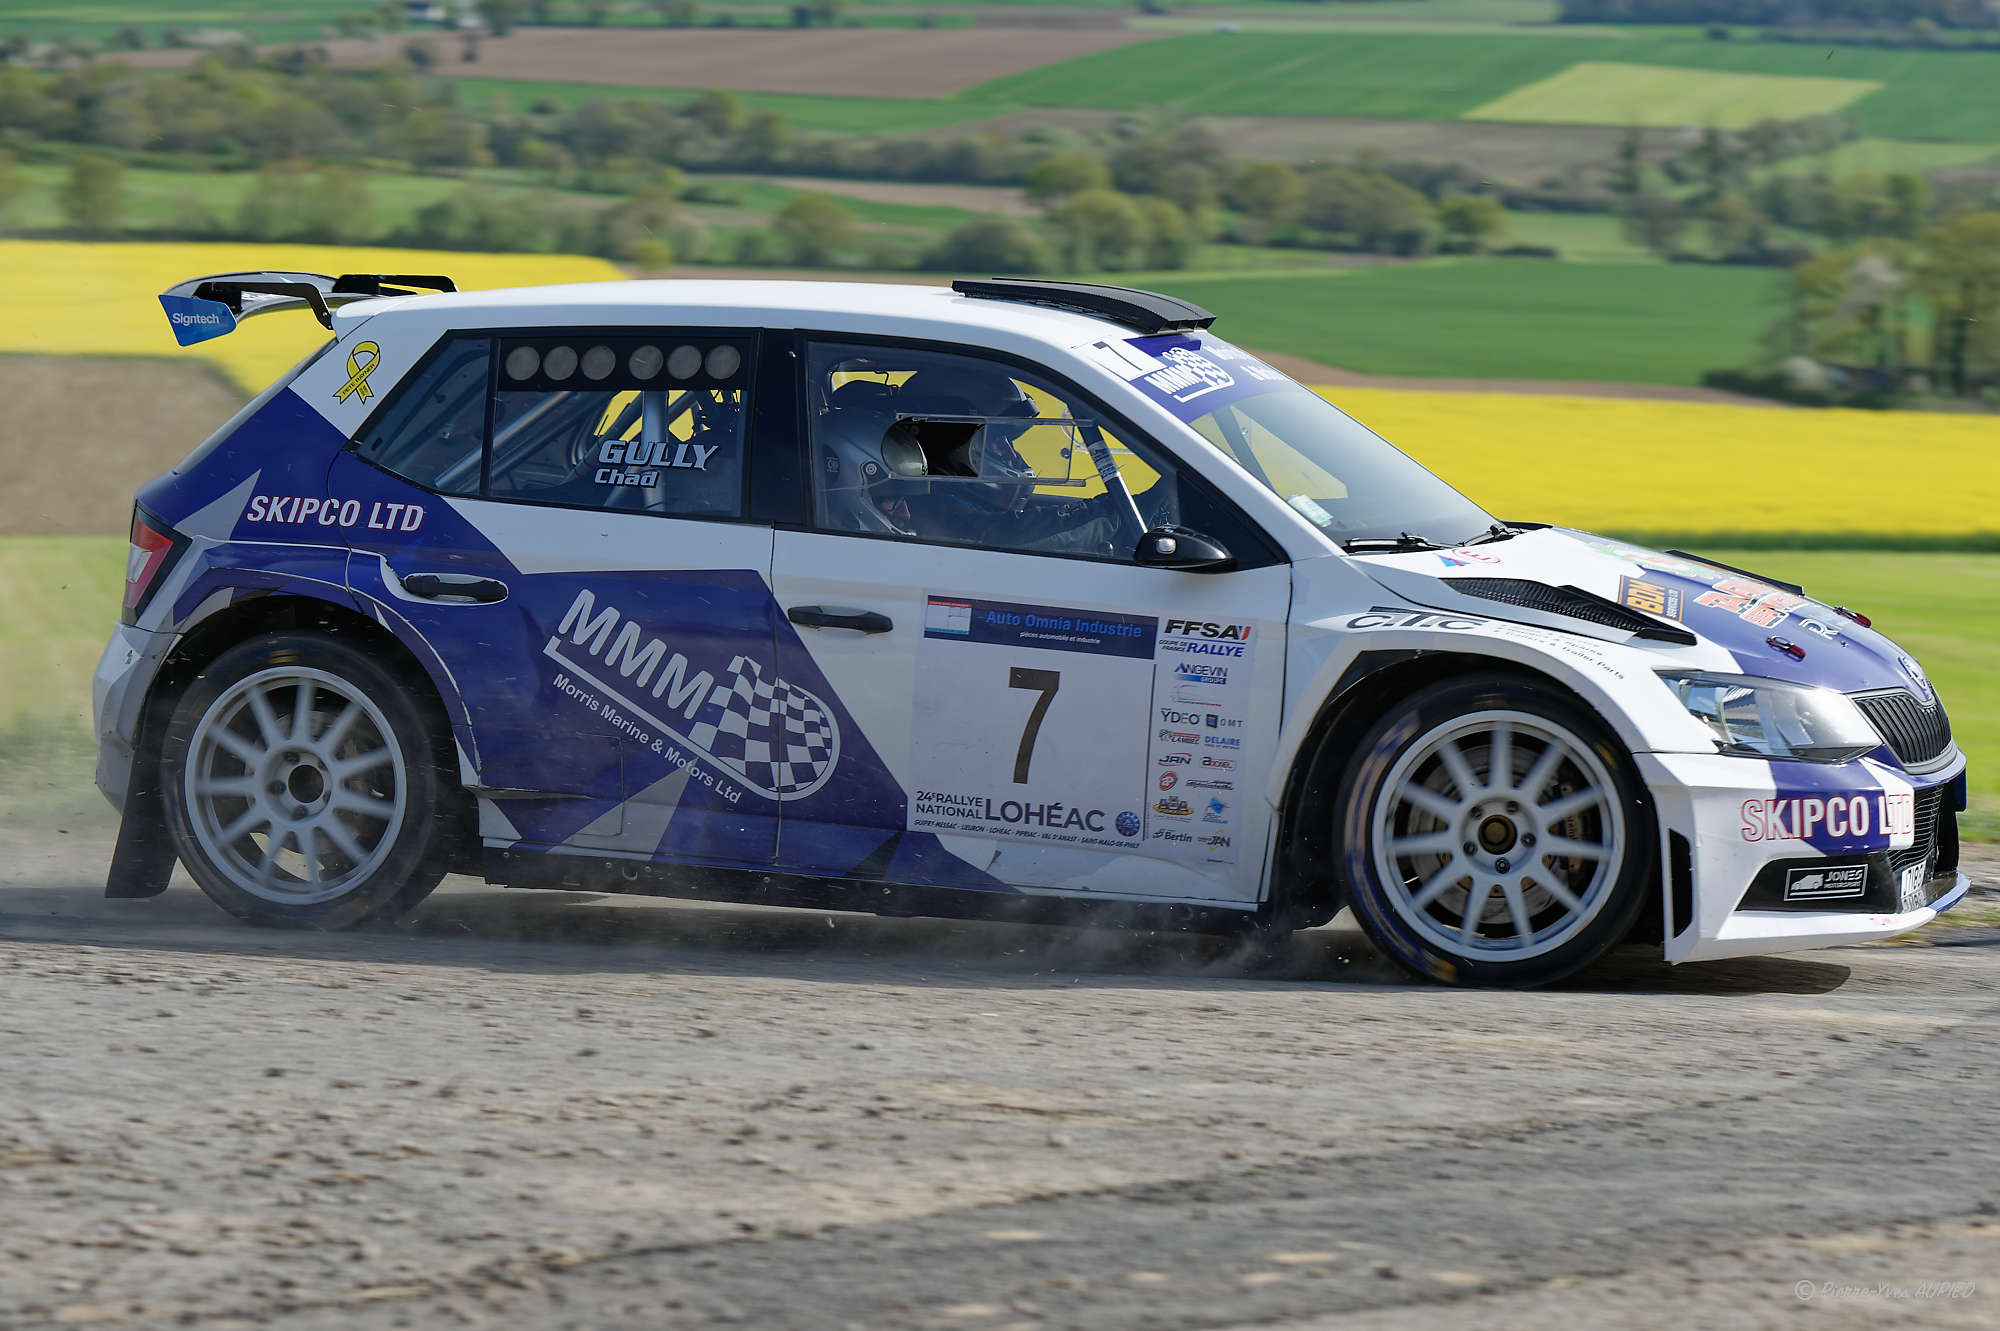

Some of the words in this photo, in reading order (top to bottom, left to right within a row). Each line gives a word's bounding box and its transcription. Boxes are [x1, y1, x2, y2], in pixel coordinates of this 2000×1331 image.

[172, 312, 219, 326] Signtech
[598, 440, 719, 469] GULLY
[594, 468, 659, 487] Chad
[246, 495, 362, 528] SKIPCO
[368, 502, 425, 532] LTD
[985, 610, 1021, 626] Auto
[1025, 613, 1071, 632] Omnia
[1075, 620, 1143, 638] Industrie
[1164, 619, 1240, 640] FFSA
[558, 588, 714, 720] MMM
[1186, 642, 1244, 657] RALLYE
[1174, 664, 1228, 676] ANGEVIN
[1009, 667, 1061, 784] 7
[553, 673, 600, 711] Morris
[600, 704, 650, 744] Marine
[651, 738, 664, 754] &
[664, 747, 714, 786] Motors
[715, 780, 742, 803] Ltd
[1204, 736, 1240, 746] DELAIRE
[936, 793, 984, 807] RALLYE
[916, 803, 983, 819] NATIONAL
[985, 799, 1105, 832] LOHÉAC
[1741, 795, 1870, 842] SKIPCO
[1878, 794, 1912, 836] LTD
[1165, 832, 1192, 843] Bertin
[1825, 869, 1864, 881] JONES
